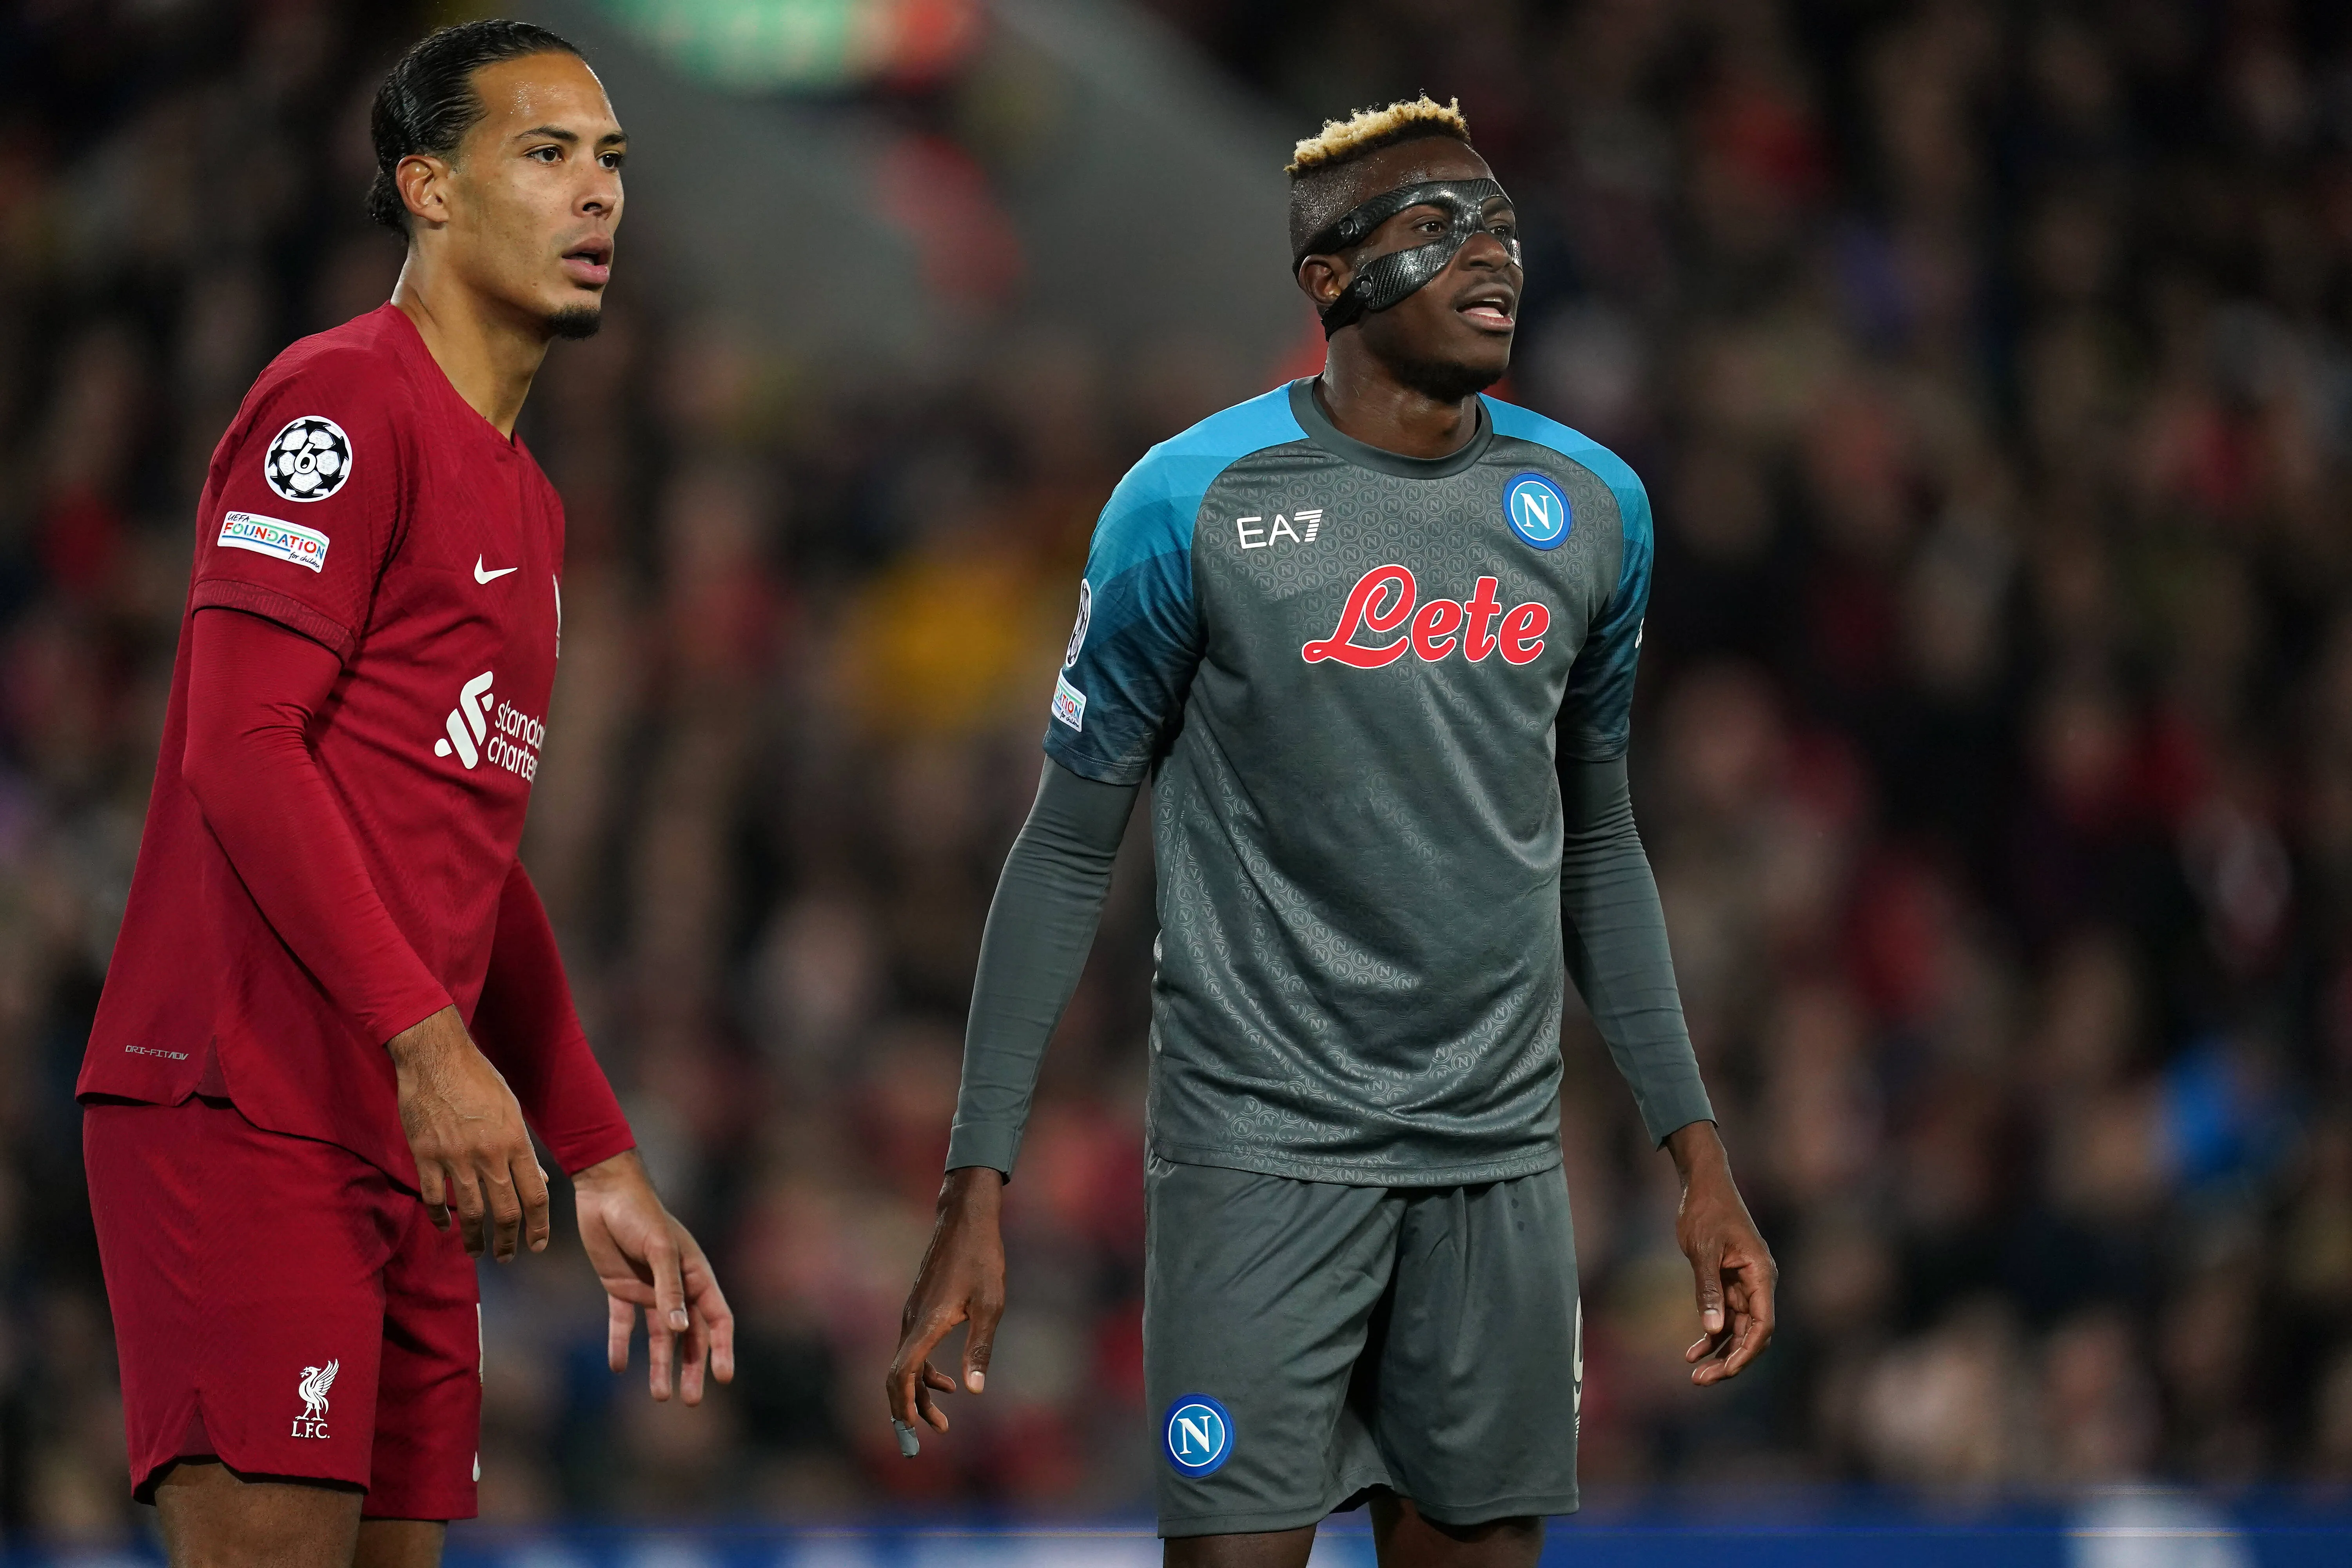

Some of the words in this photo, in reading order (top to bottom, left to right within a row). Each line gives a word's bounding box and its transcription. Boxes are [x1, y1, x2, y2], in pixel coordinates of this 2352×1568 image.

[294, 443, 317, 474] 6
[227, 513, 250, 523] UEFA
[1237, 509, 1323, 549] EA7
[1520, 493, 1550, 530] N
[223, 523, 325, 560] FOUNDATION
[300, 555, 320, 569] children
[1301, 564, 1550, 669] Lete
[1054, 685, 1081, 719] DATION
[291, 1421, 330, 1439] L.F.C.
[1178, 1416, 1211, 1454] N
